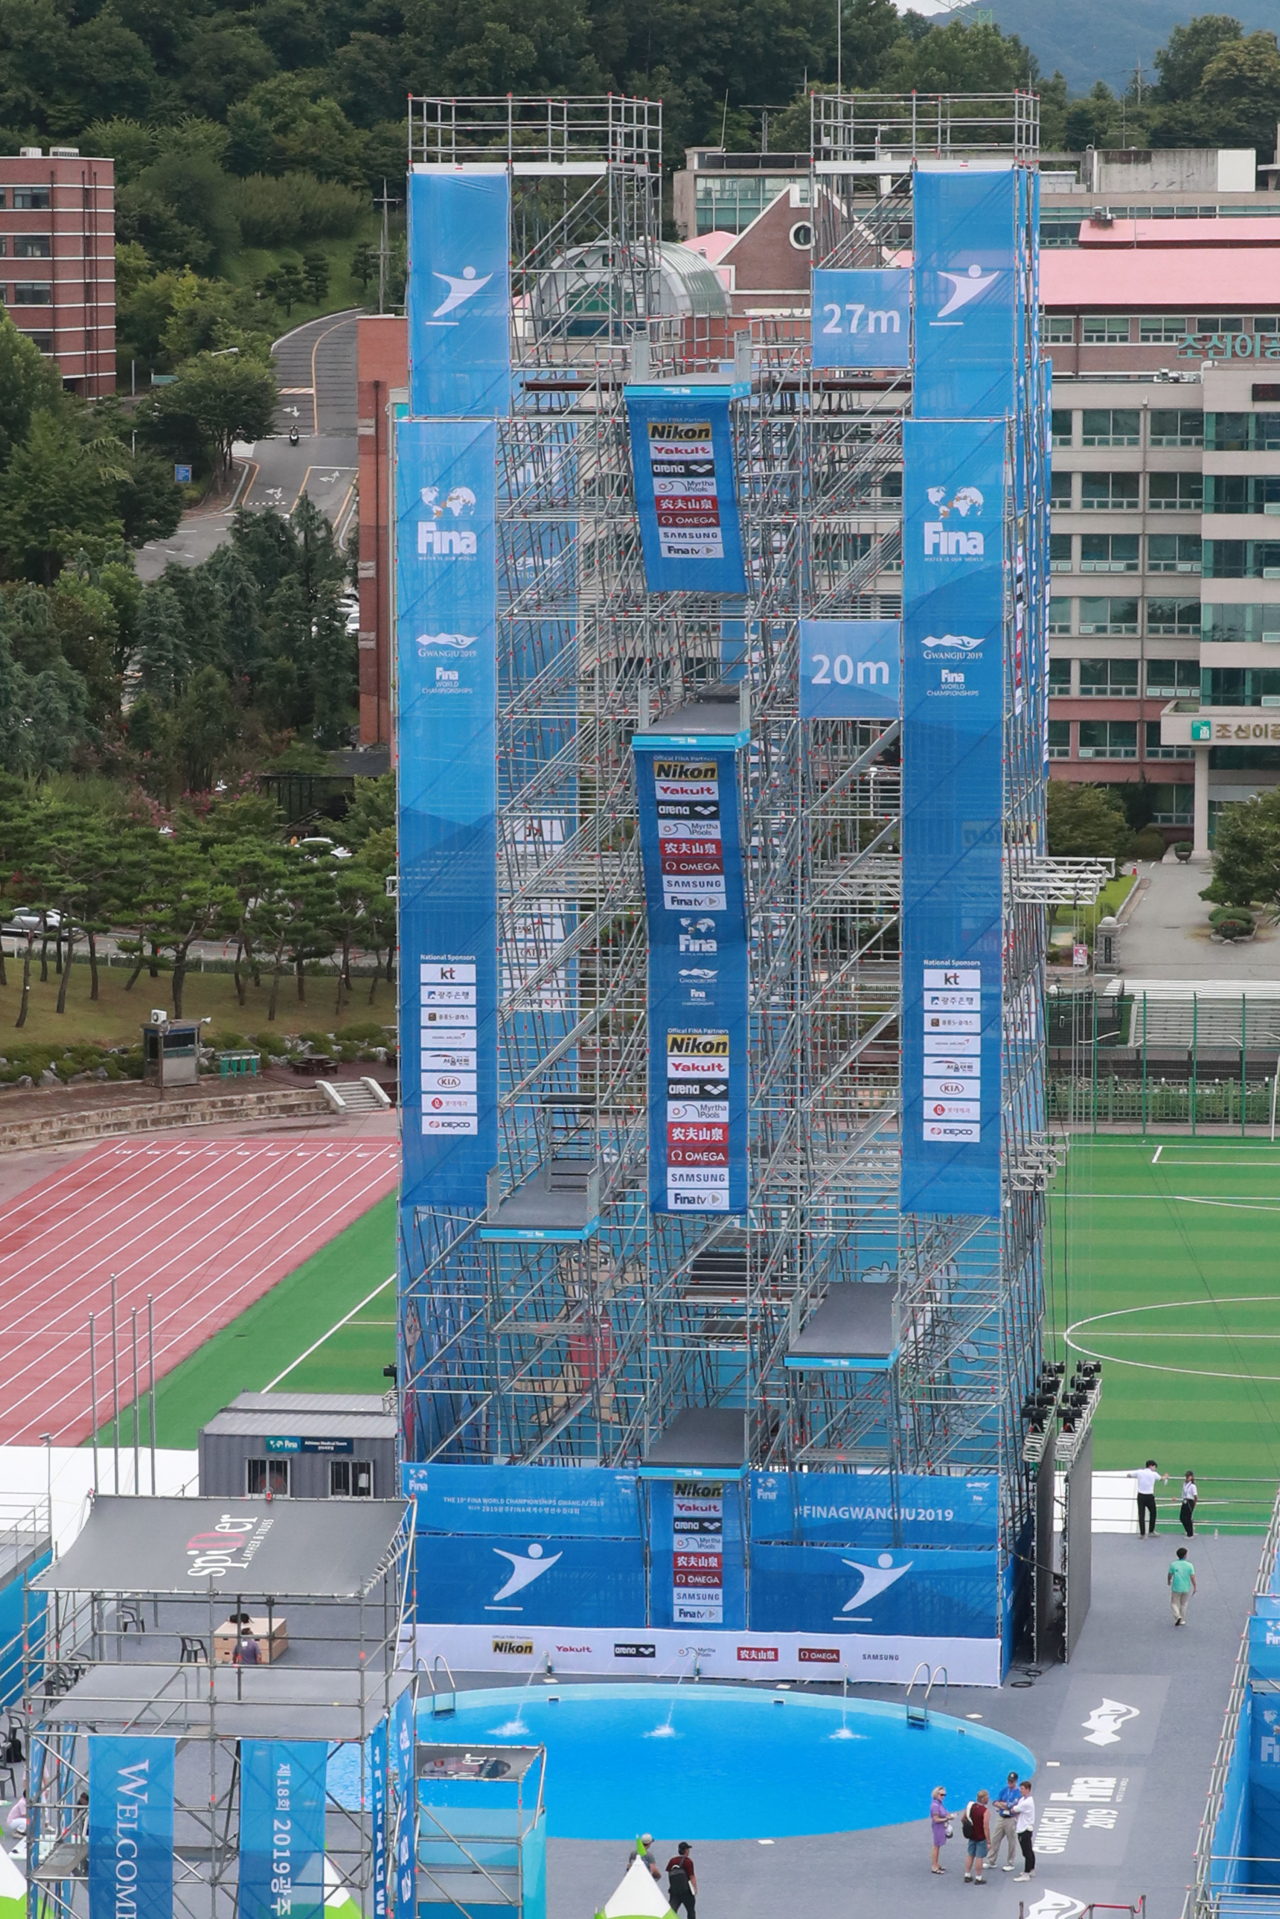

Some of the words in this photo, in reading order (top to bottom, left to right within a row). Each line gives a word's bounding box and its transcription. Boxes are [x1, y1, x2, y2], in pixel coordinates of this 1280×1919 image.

[823, 304, 900, 333] 27m
[650, 425, 711, 439] Nikon
[654, 446, 710, 454] Yakult
[653, 464, 684, 473] arena
[660, 499, 712, 509] 农夫山泉
[418, 522, 478, 554] Fina
[924, 522, 984, 554] Fina
[418, 649, 459, 658] GWANGJU
[924, 650, 966, 660] GWANGJU
[436, 667, 458, 680] Fina
[812, 654, 889, 684] 20m
[941, 669, 964, 682] Fina
[656, 764, 716, 778] Nikon
[660, 786, 715, 795] Yakult
[658, 806, 690, 814] arena
[664, 843, 716, 854] 农夫山泉
[680, 862, 720, 870] OMEGA
[666, 880, 721, 888] SAMSUNG
[679, 934, 718, 952] Fina
[440, 968, 456, 980] kt
[944, 973, 960, 986] kt
[438, 991, 470, 1000] 광주은행
[690, 989, 706, 998] Fina
[941, 996, 974, 1005] 광주은행
[670, 1037, 728, 1053] Nikon
[672, 1062, 725, 1072] Yakult
[669, 1084, 700, 1094] arena
[700, 1104, 726, 1112] Myrtha
[672, 1128, 723, 1140] 农夫山泉
[686, 1152, 725, 1160] OMEGA
[672, 1174, 725, 1182] SAMSUNG
[409, 1480, 428, 1491] Fina
[676, 1484, 721, 1497] Nikon
[757, 1489, 777, 1500] Fina
[794, 1506, 954, 1522] #FINAGWANGJU2019
[677, 1556, 718, 1567] 农夫山泉
[494, 1642, 532, 1653] Nikon
[810, 1652, 838, 1660] OMEGA
[1050, 1777, 1118, 1802] Fina
[1032, 1808, 1076, 1854] GWANGJU
[1082, 1808, 1118, 1830] 2019
